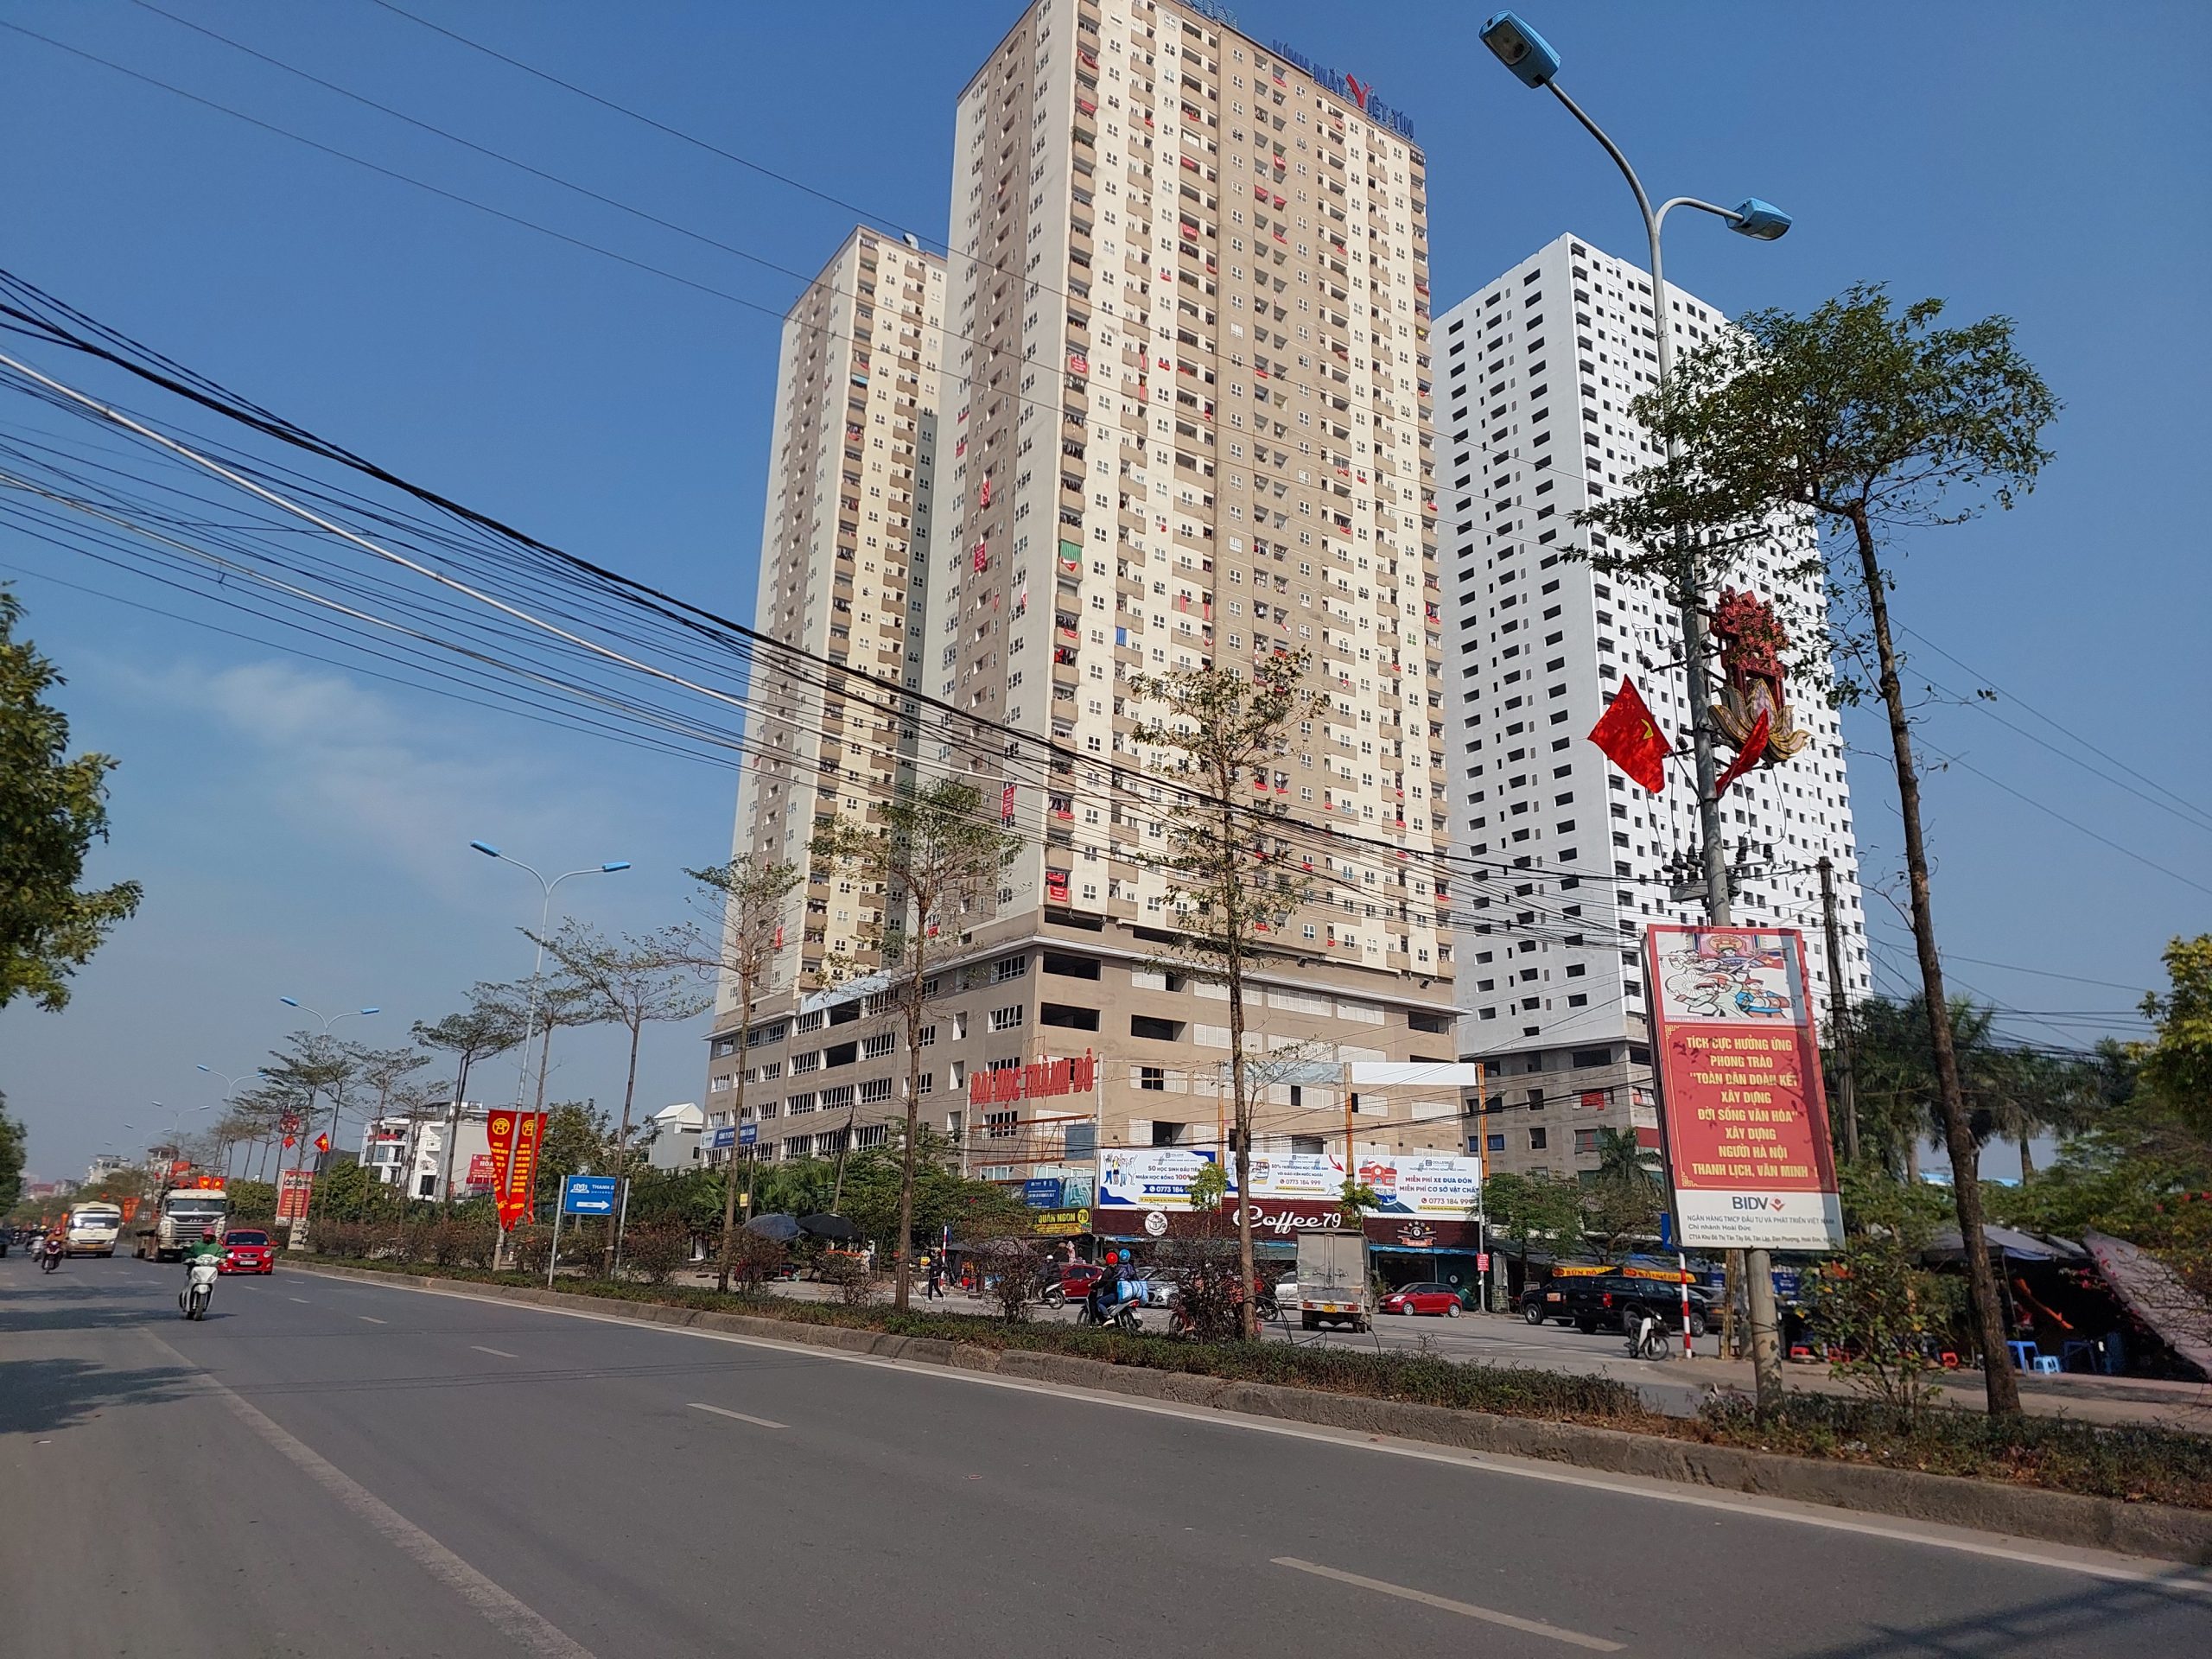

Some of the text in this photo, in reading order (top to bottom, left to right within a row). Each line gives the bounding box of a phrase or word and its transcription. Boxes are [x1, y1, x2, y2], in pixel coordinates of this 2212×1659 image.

[1686, 1034, 1793, 1052] TÍCH CỰC HƯỞNG ỨNG
[1710, 1053, 1773, 1068] PHONG TRÀO
[970, 1047, 1095, 1111] ĐẠI HỌC THÀNH ĐÔ
[1721, 1089, 1772, 1106] XÂY DỰNG
[1718, 1104, 1746, 1122] SỐNG
[1747, 1108, 1771, 1122] VĂN
[1725, 1125, 1777, 1141] XÂY DỰNG
[1718, 1142, 1788, 1161] NGƯỜI HÀ NỘI
[1692, 1163, 1726, 1176] THANH
[1728, 1164, 1756, 1179] LỊCH,
[1757, 1162, 1778, 1177] VĂN
[1781, 1165, 1808, 1178] MINH
[1732, 1196, 1769, 1211] BIDV
[1038, 1211, 1088, 1224] QUÁN NGON 79
[1232, 1205, 1342, 1235] Coffee 79
